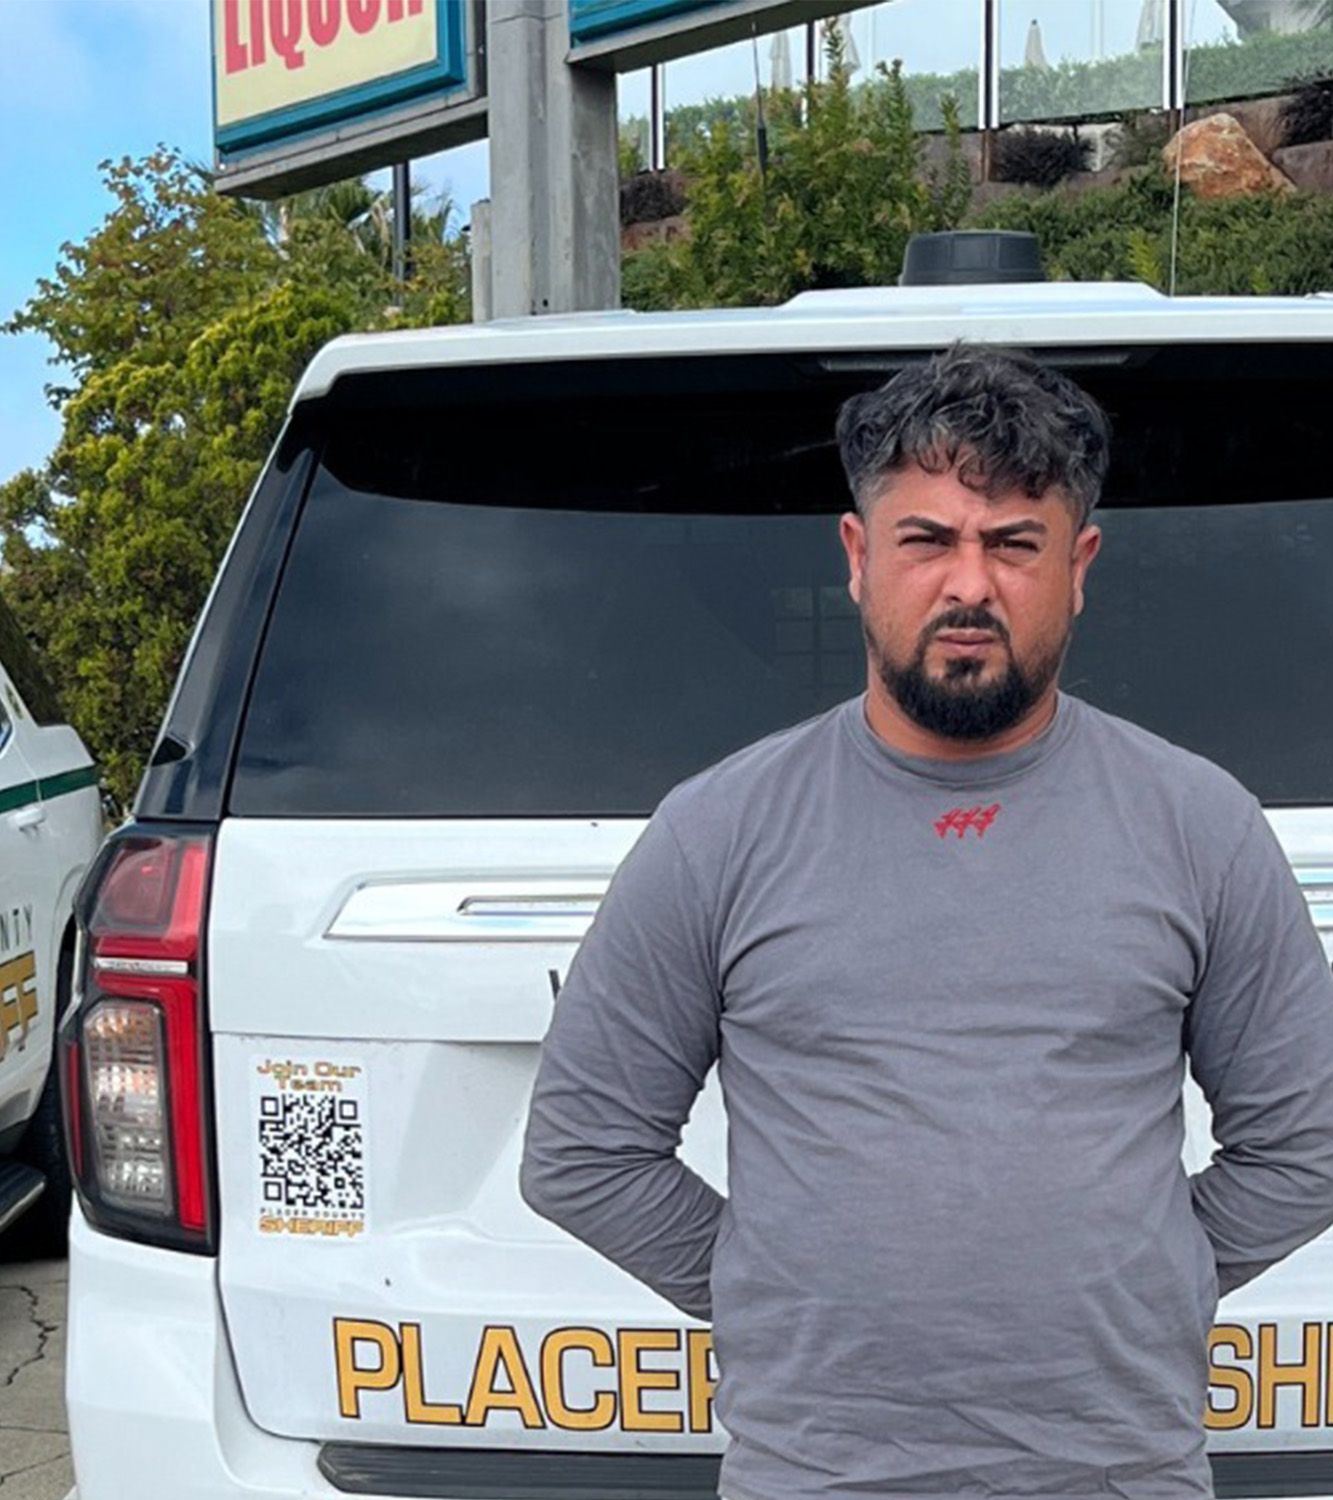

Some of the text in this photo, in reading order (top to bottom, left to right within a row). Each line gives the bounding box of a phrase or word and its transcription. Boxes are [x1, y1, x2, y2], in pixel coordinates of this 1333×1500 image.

[257, 1059, 362, 1078] Join Our
[274, 1074, 343, 1092] Team
